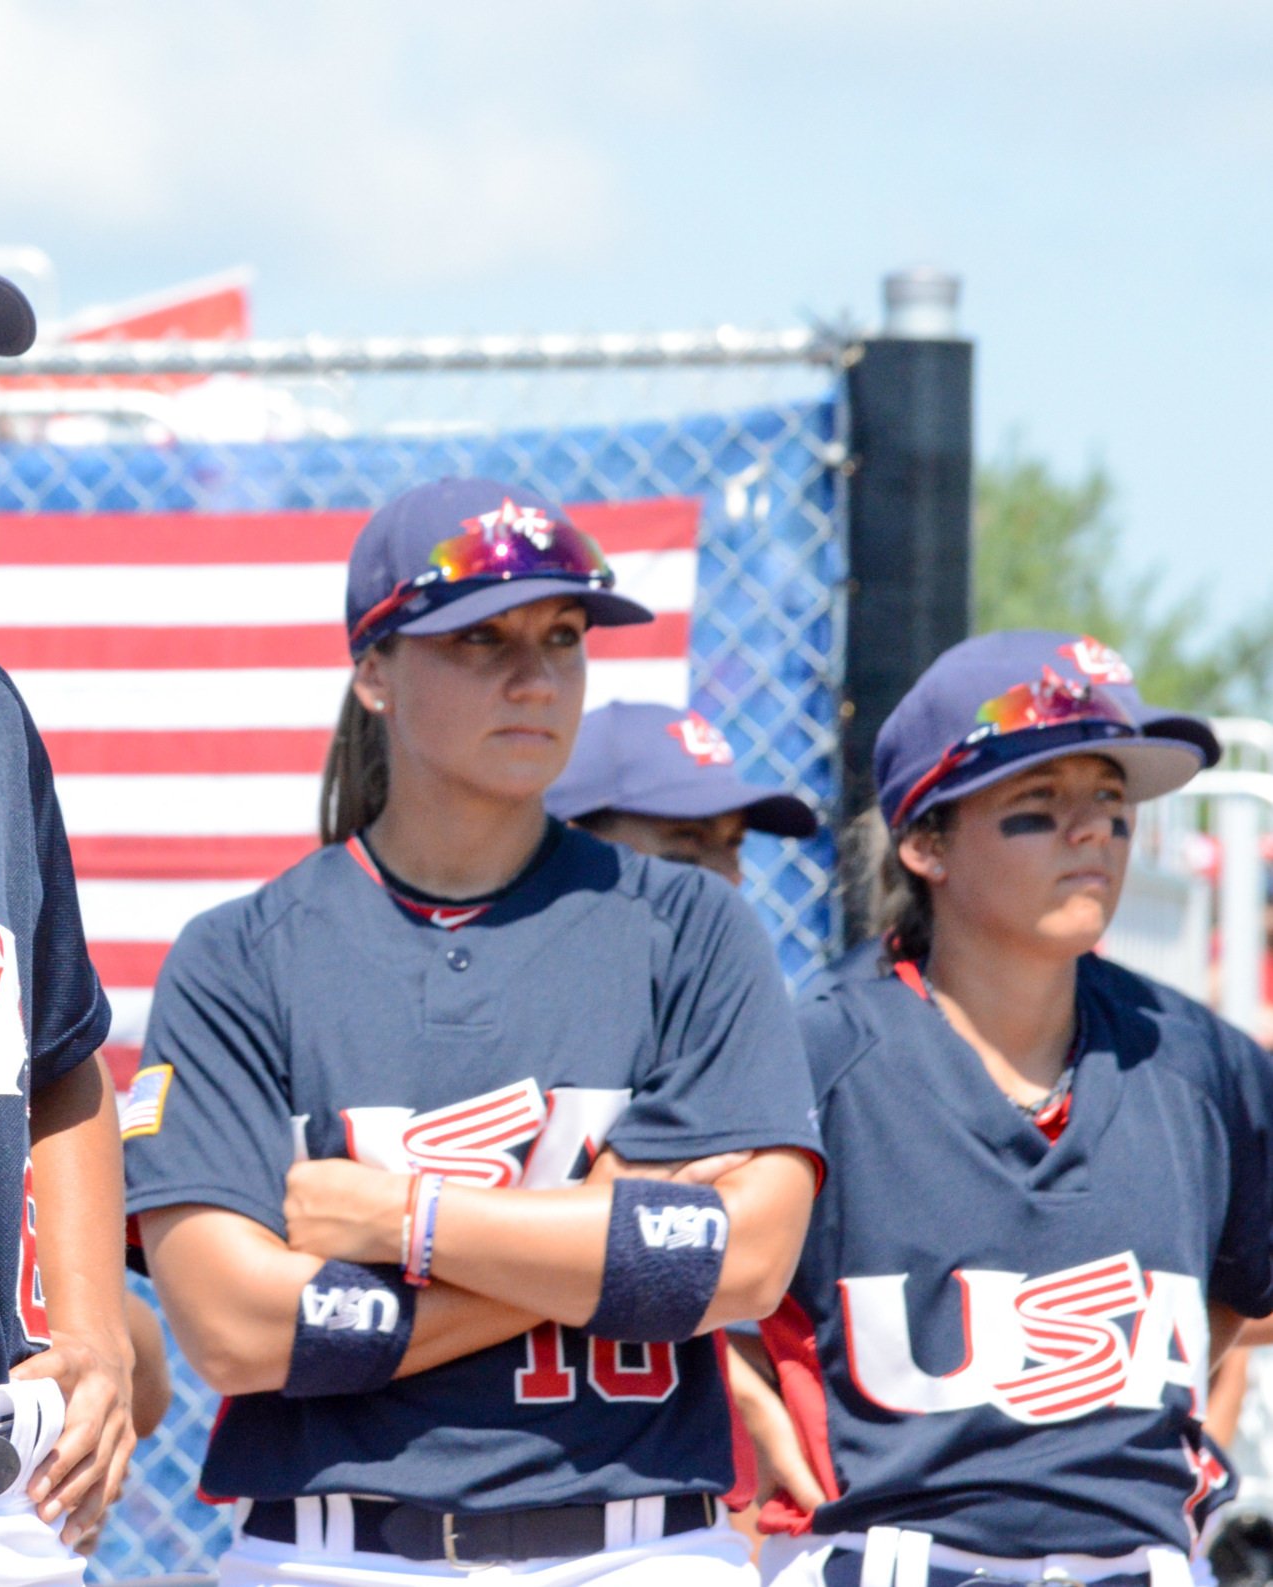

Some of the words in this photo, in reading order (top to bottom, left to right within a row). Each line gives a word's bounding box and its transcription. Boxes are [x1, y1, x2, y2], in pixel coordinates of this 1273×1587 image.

[632, 1204, 729, 1252] USA
[301, 1283, 401, 1333] USA
[836, 1250, 1211, 1424] USA
